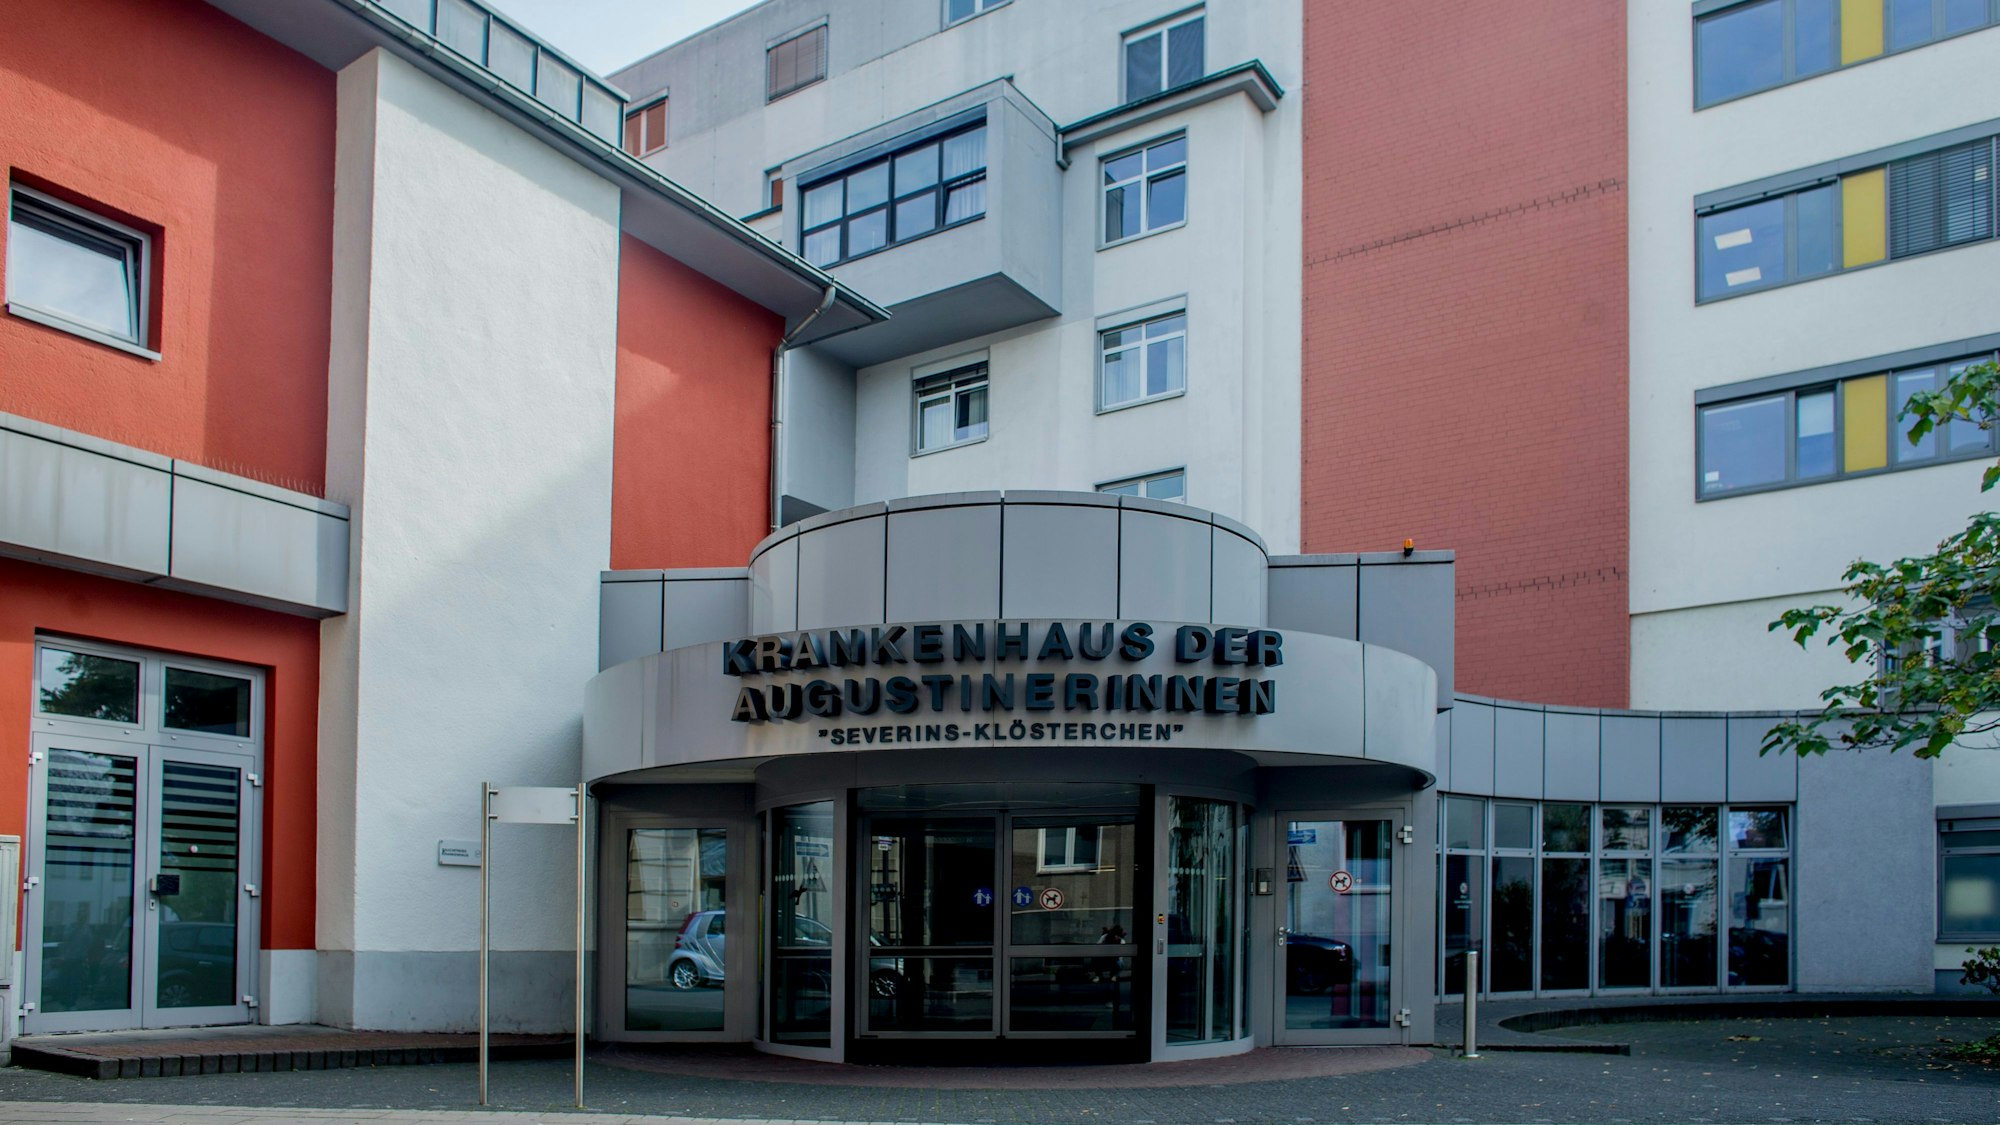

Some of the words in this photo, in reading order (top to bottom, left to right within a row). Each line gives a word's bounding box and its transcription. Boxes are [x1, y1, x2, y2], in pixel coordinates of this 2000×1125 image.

[723, 622, 1155, 677] KRANKENHAUS
[1175, 625, 1284, 667] DER
[730, 672, 1276, 726] AUGUSTINERINNEN
